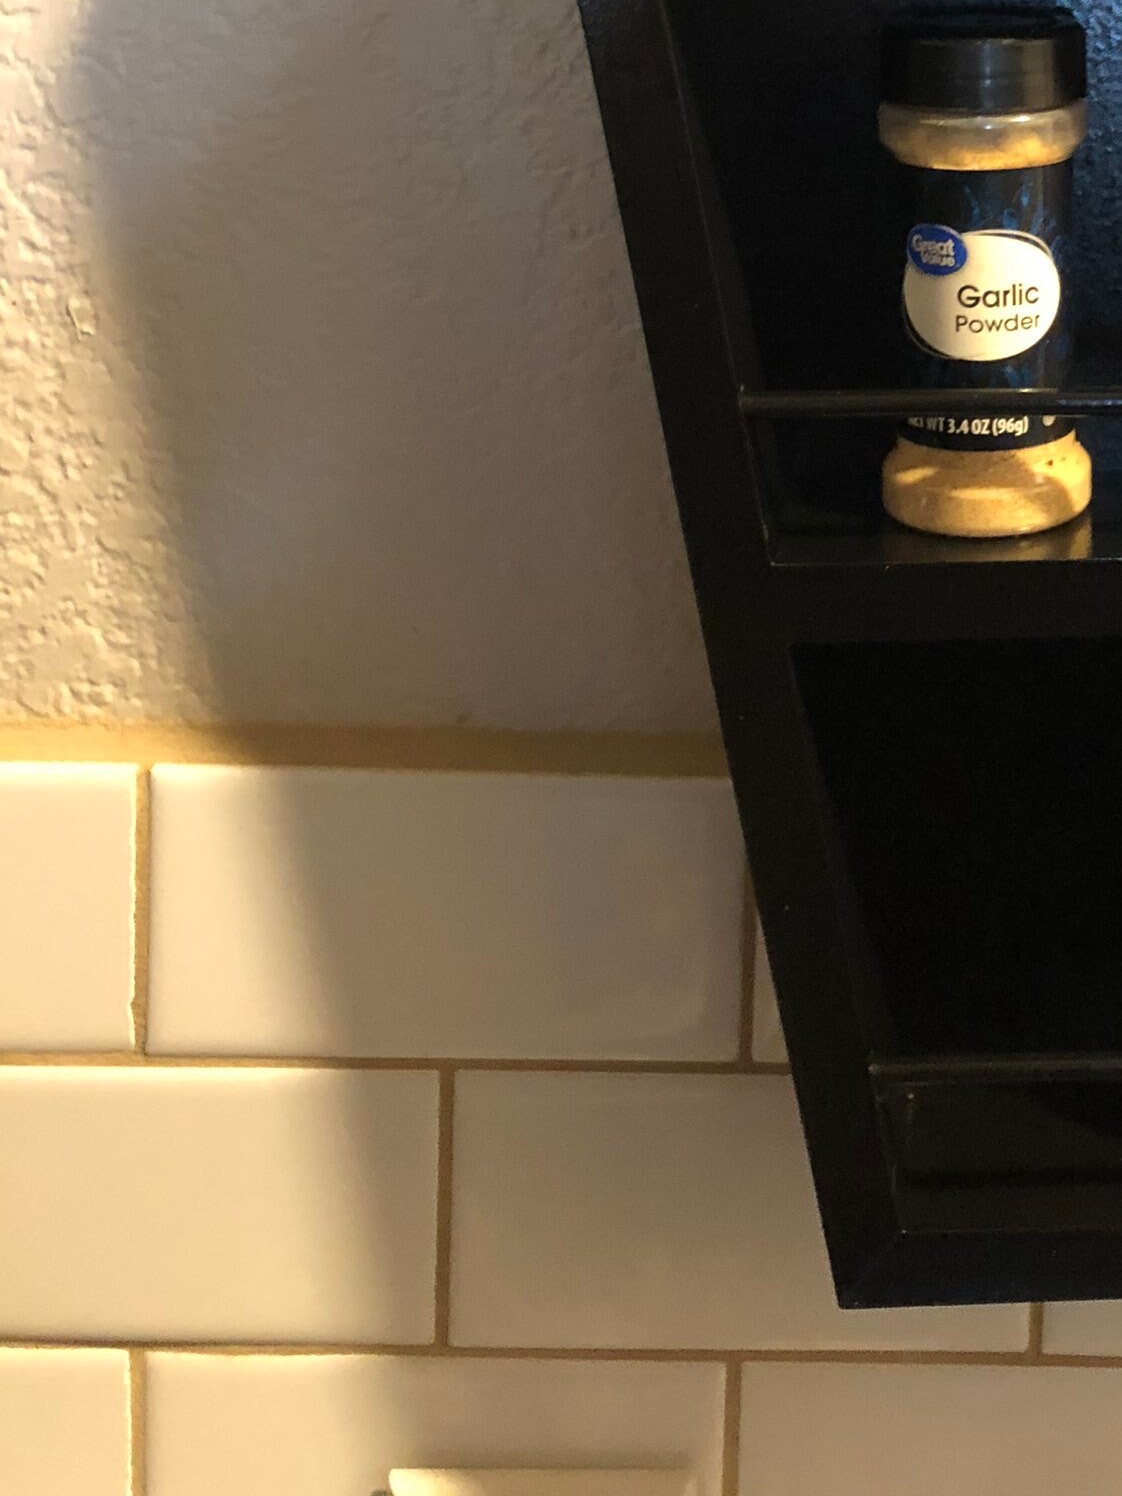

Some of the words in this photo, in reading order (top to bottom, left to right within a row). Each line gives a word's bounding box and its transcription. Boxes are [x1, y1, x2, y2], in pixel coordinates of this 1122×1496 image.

[912, 234, 955, 256] Great
[921, 251, 956, 267] Value
[957, 283, 1040, 308] Garlic
[955, 313, 1040, 333] Powder
[926, 416, 946, 432] WT
[947, 418, 970, 434] 3.4
[972, 418, 990, 435] OZ
[992, 415, 1029, 437] (96g)
